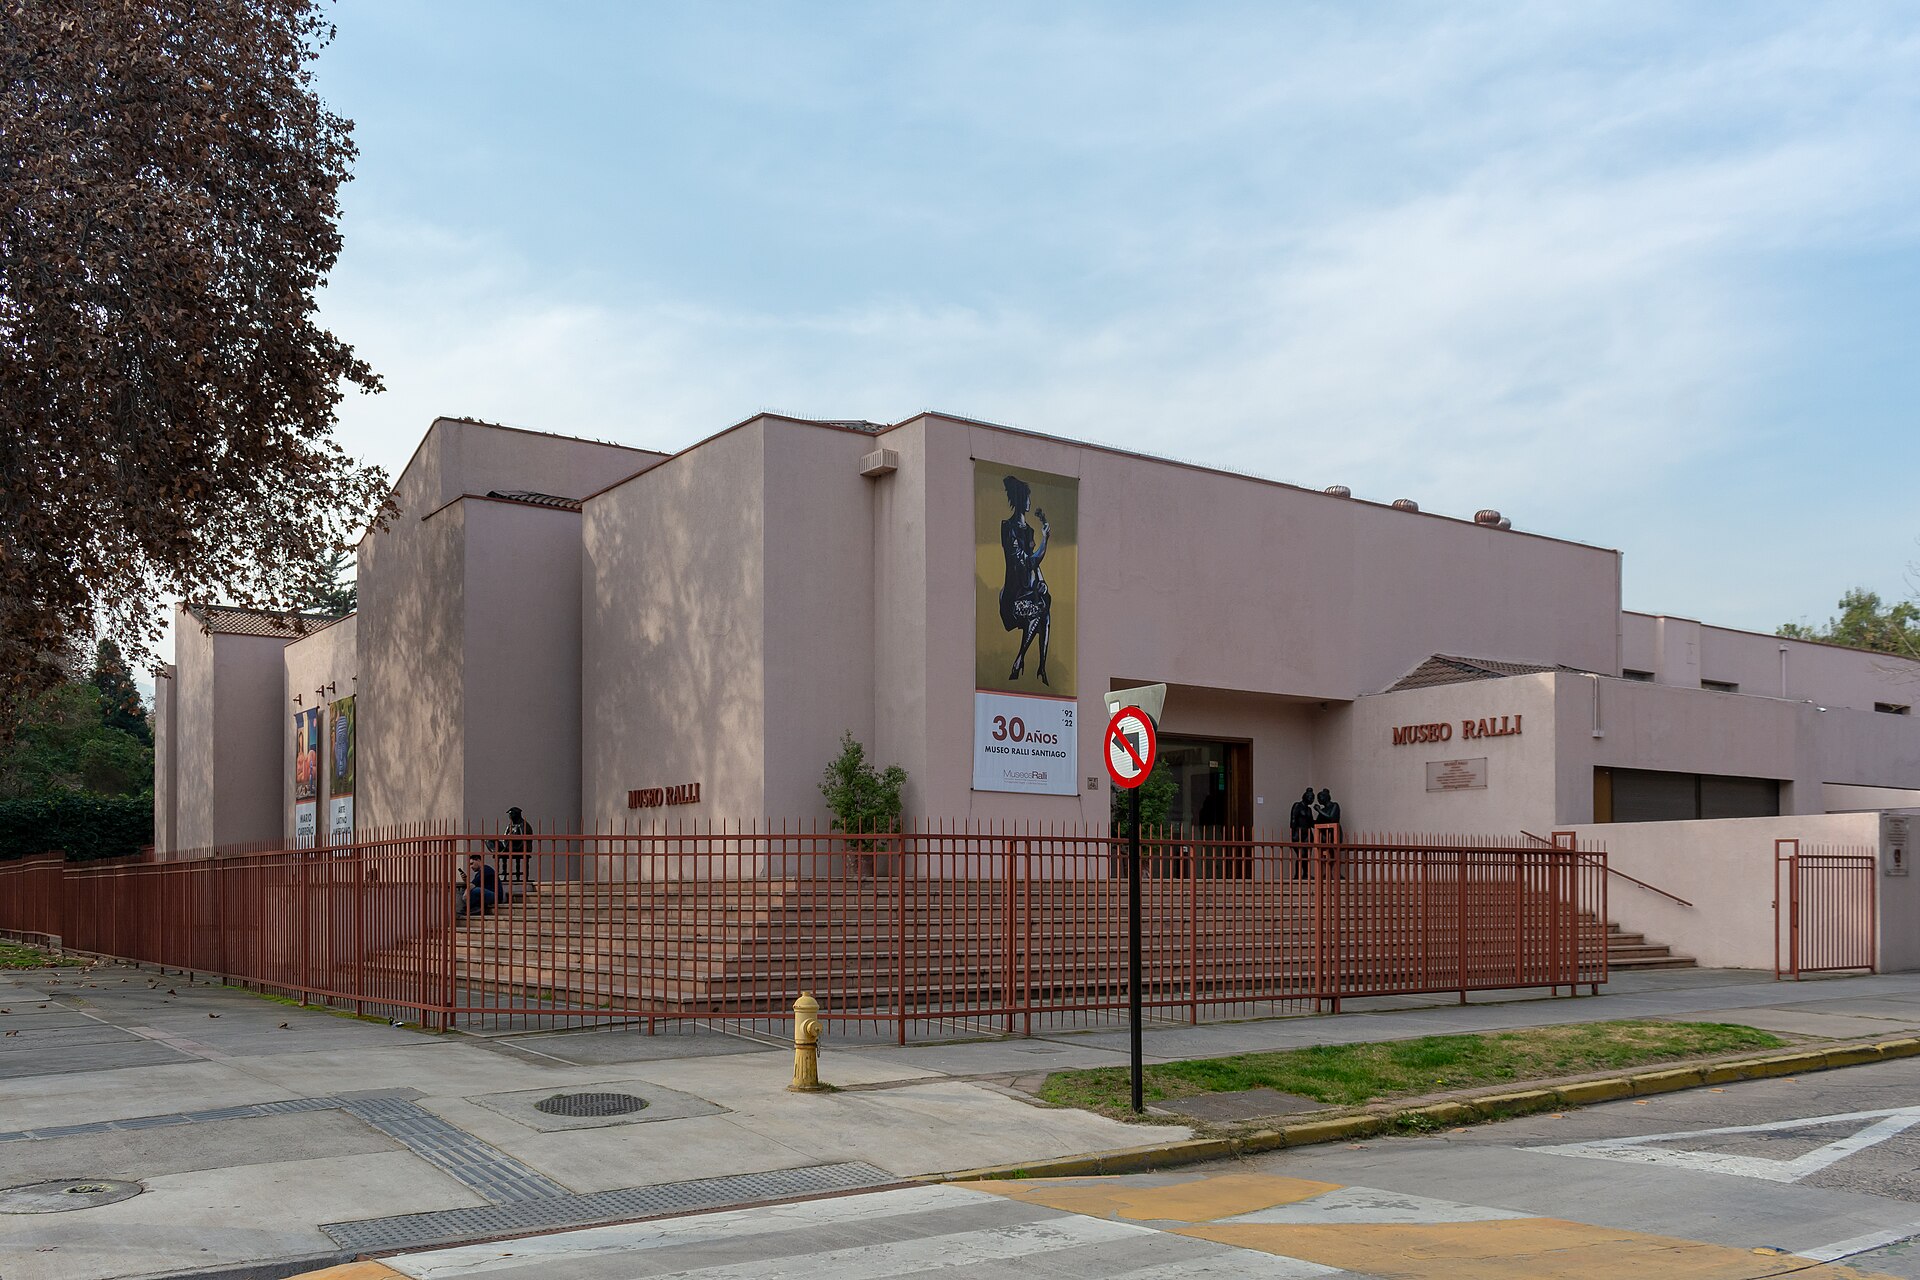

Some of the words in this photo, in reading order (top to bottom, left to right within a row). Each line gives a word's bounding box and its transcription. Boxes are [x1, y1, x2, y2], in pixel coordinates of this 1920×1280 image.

[992, 715, 1025, 742] 30
[1026, 730, 1058, 744] AÑOS
[1392, 722, 1452, 746] MUSEO
[1462, 714, 1522, 740] RALLI
[984, 746, 1010, 754] MUSEO
[1011, 748, 1030, 756] RALLI
[1031, 750, 1066, 758] SANTIAGO
[628, 788, 664, 809] MUSEO
[665, 782, 701, 806] RALLI
[300, 813, 312, 824] MARIO
